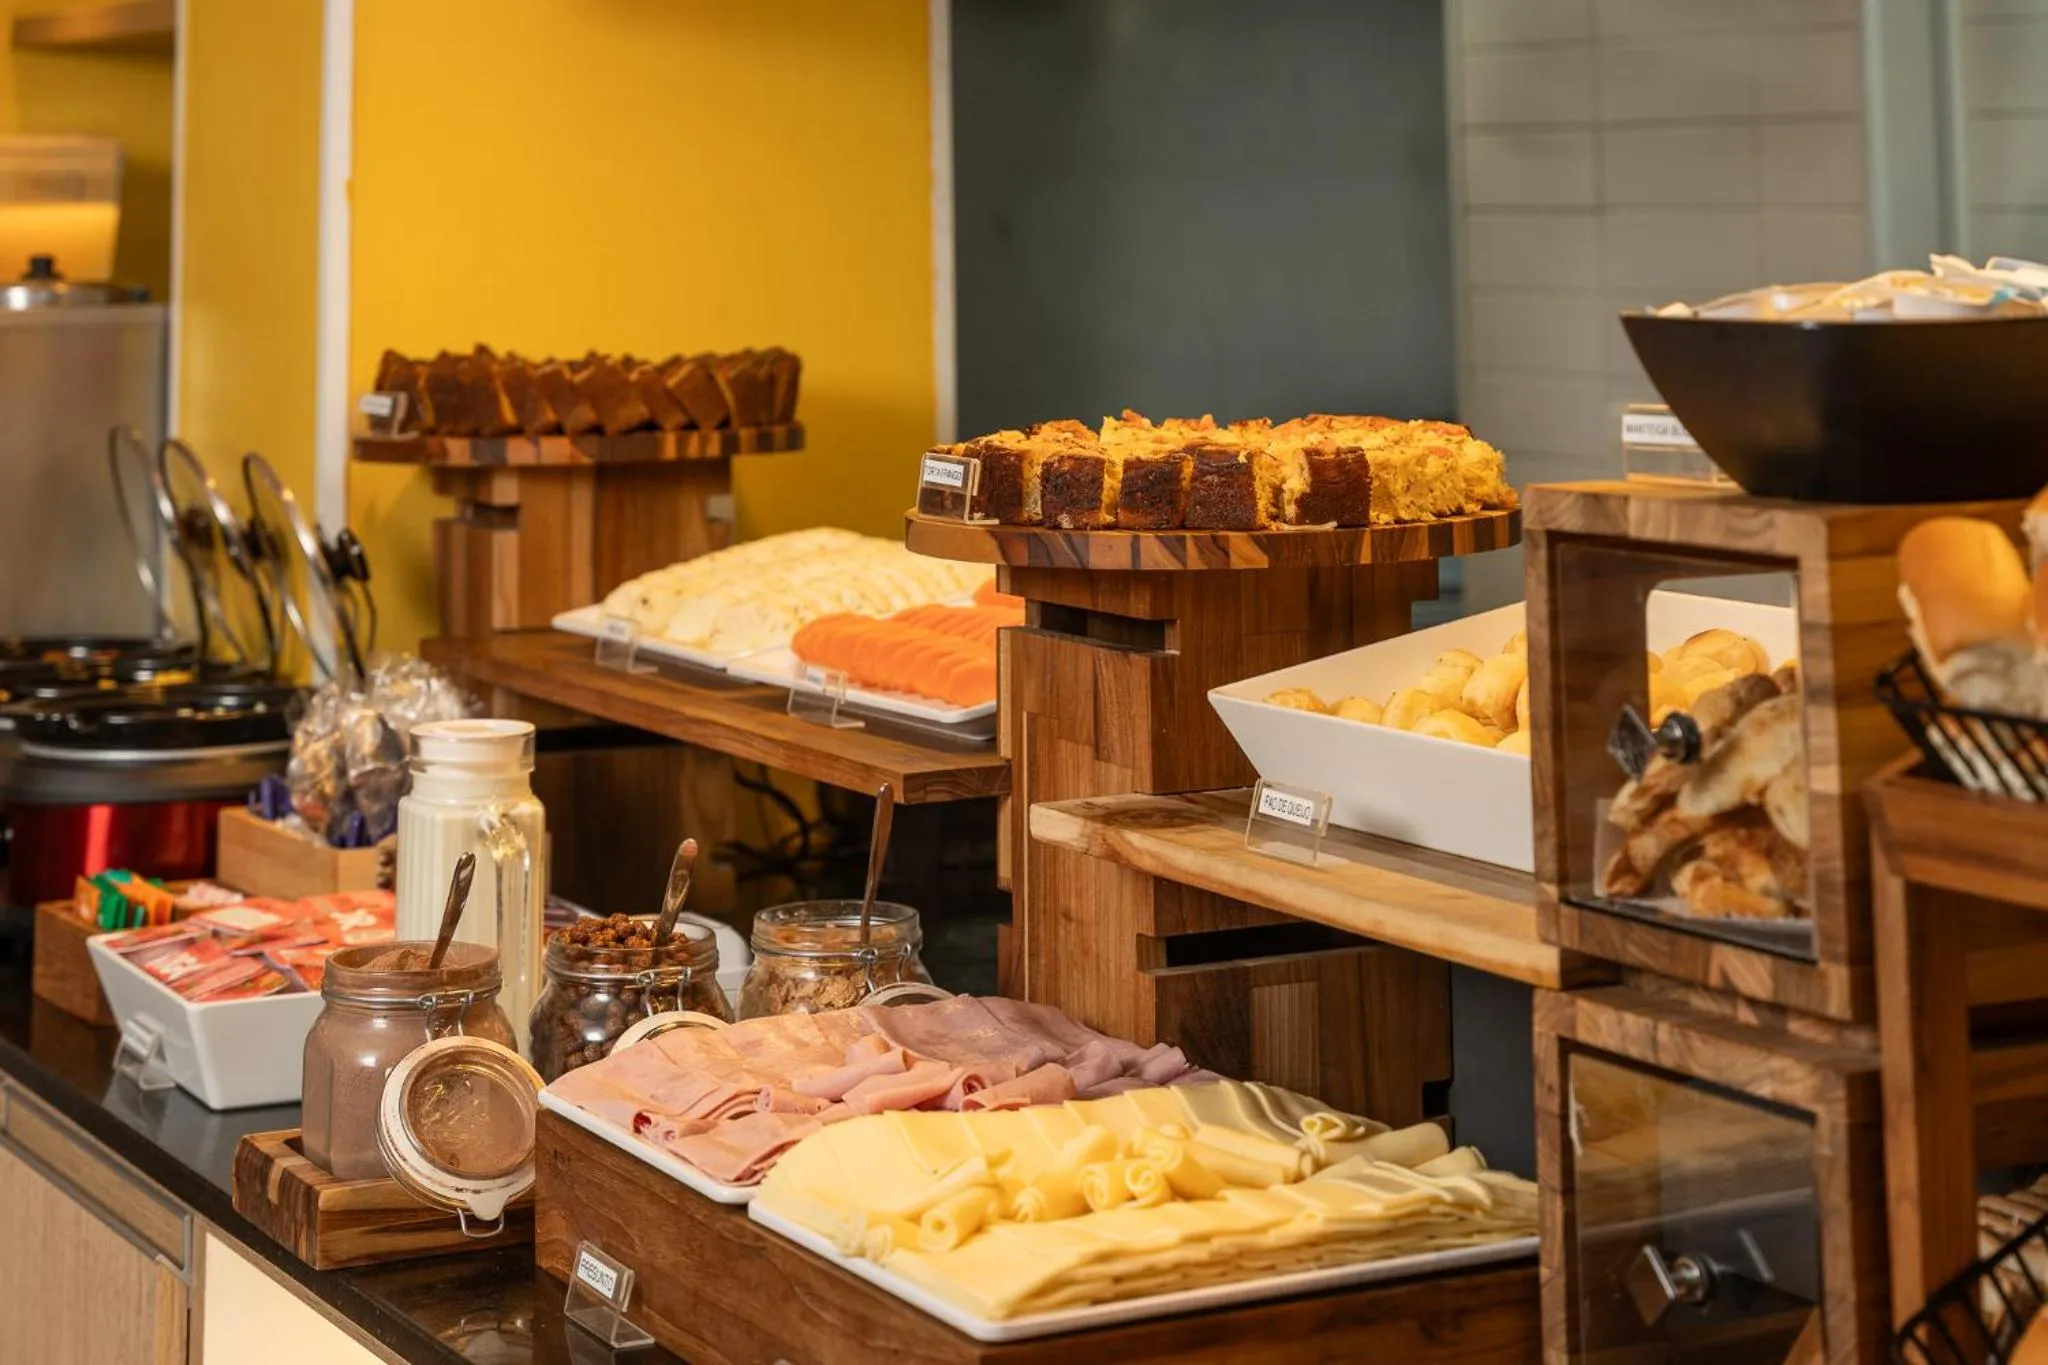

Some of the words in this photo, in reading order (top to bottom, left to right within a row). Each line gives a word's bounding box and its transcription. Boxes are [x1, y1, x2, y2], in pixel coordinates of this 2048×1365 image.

[1277, 798, 1287, 813] DE
[1287, 801, 1311, 819] QUEIJO
[581, 1258, 613, 1291] PRESUNTO
